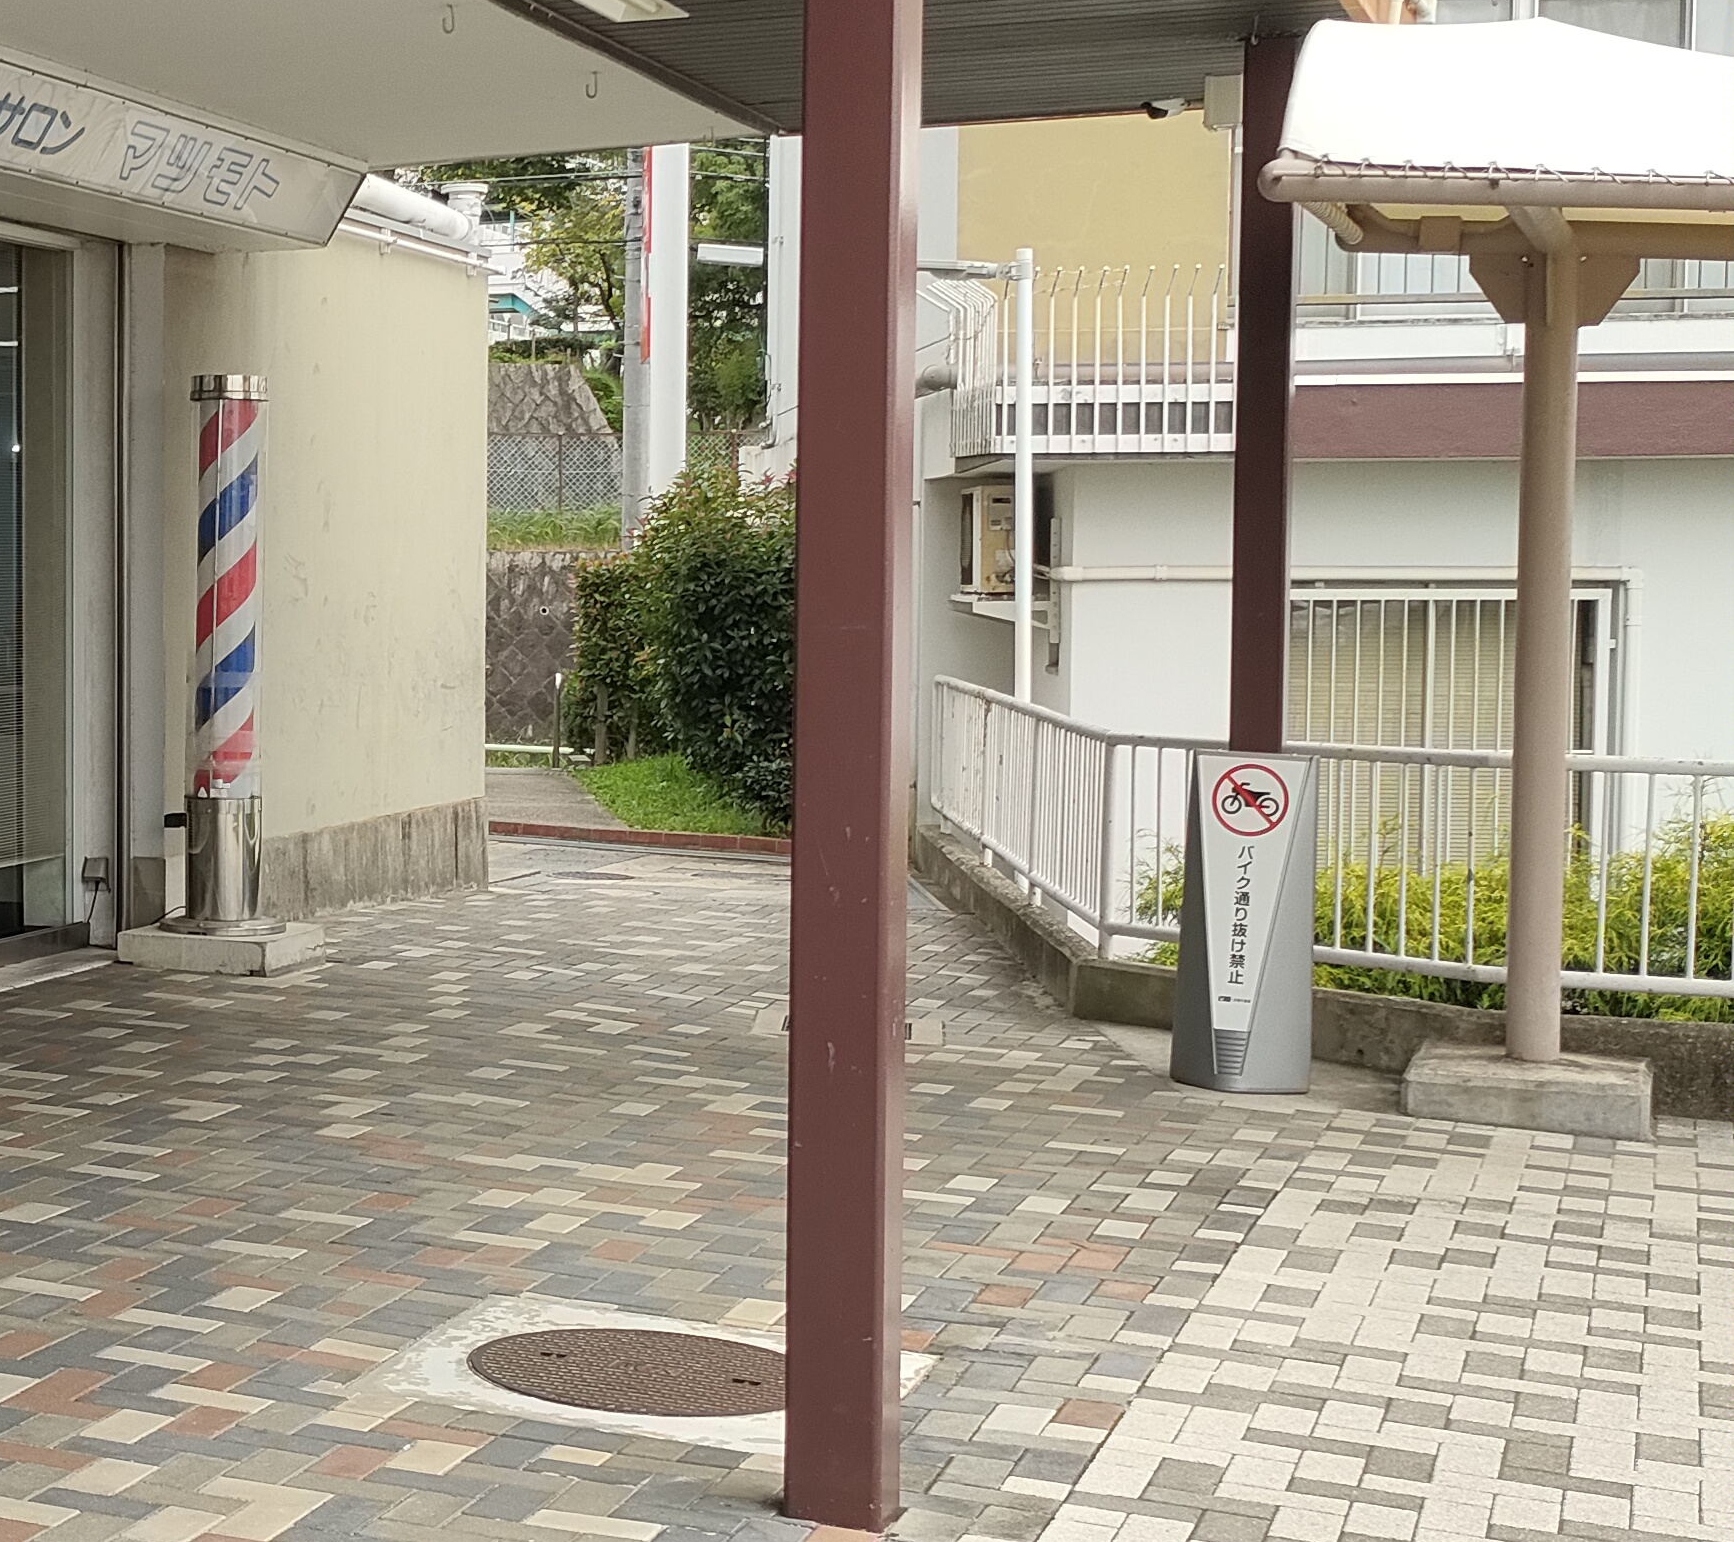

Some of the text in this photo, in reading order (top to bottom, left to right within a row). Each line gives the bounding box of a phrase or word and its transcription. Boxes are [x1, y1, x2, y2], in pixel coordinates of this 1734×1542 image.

[119, 119, 281, 211] マツモト
[1227, 844, 1255, 986] バイク通り抜け禁止
